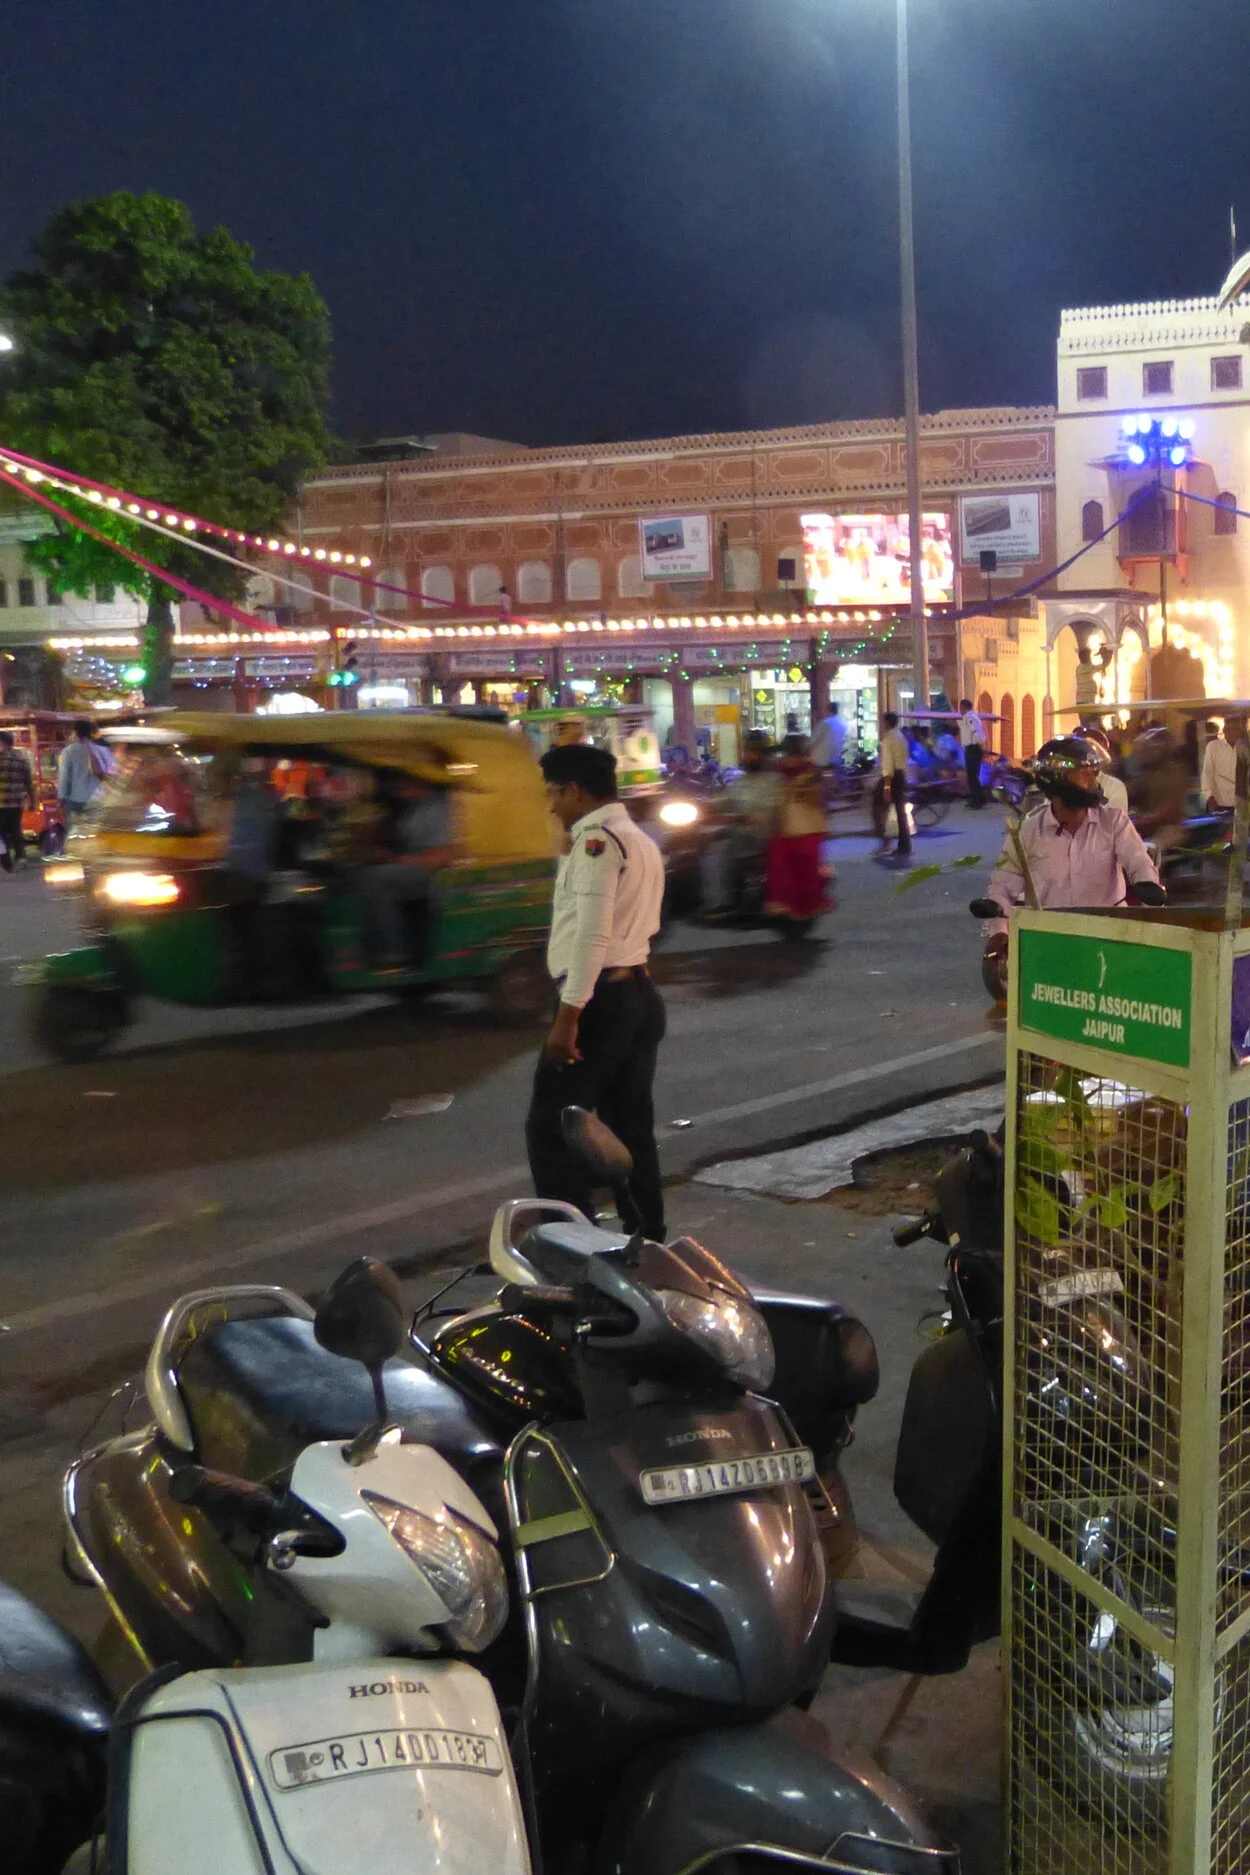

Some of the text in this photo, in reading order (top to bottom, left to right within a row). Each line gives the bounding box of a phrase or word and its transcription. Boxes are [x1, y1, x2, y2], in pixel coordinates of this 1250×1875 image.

[1031, 982, 1182, 1029] JEWELLERS ASSOCIATION
[1082, 1018, 1125, 1044] JAIPUR
[666, 1427, 733, 1448] HONDA
[348, 1681, 430, 1699] HONDA
